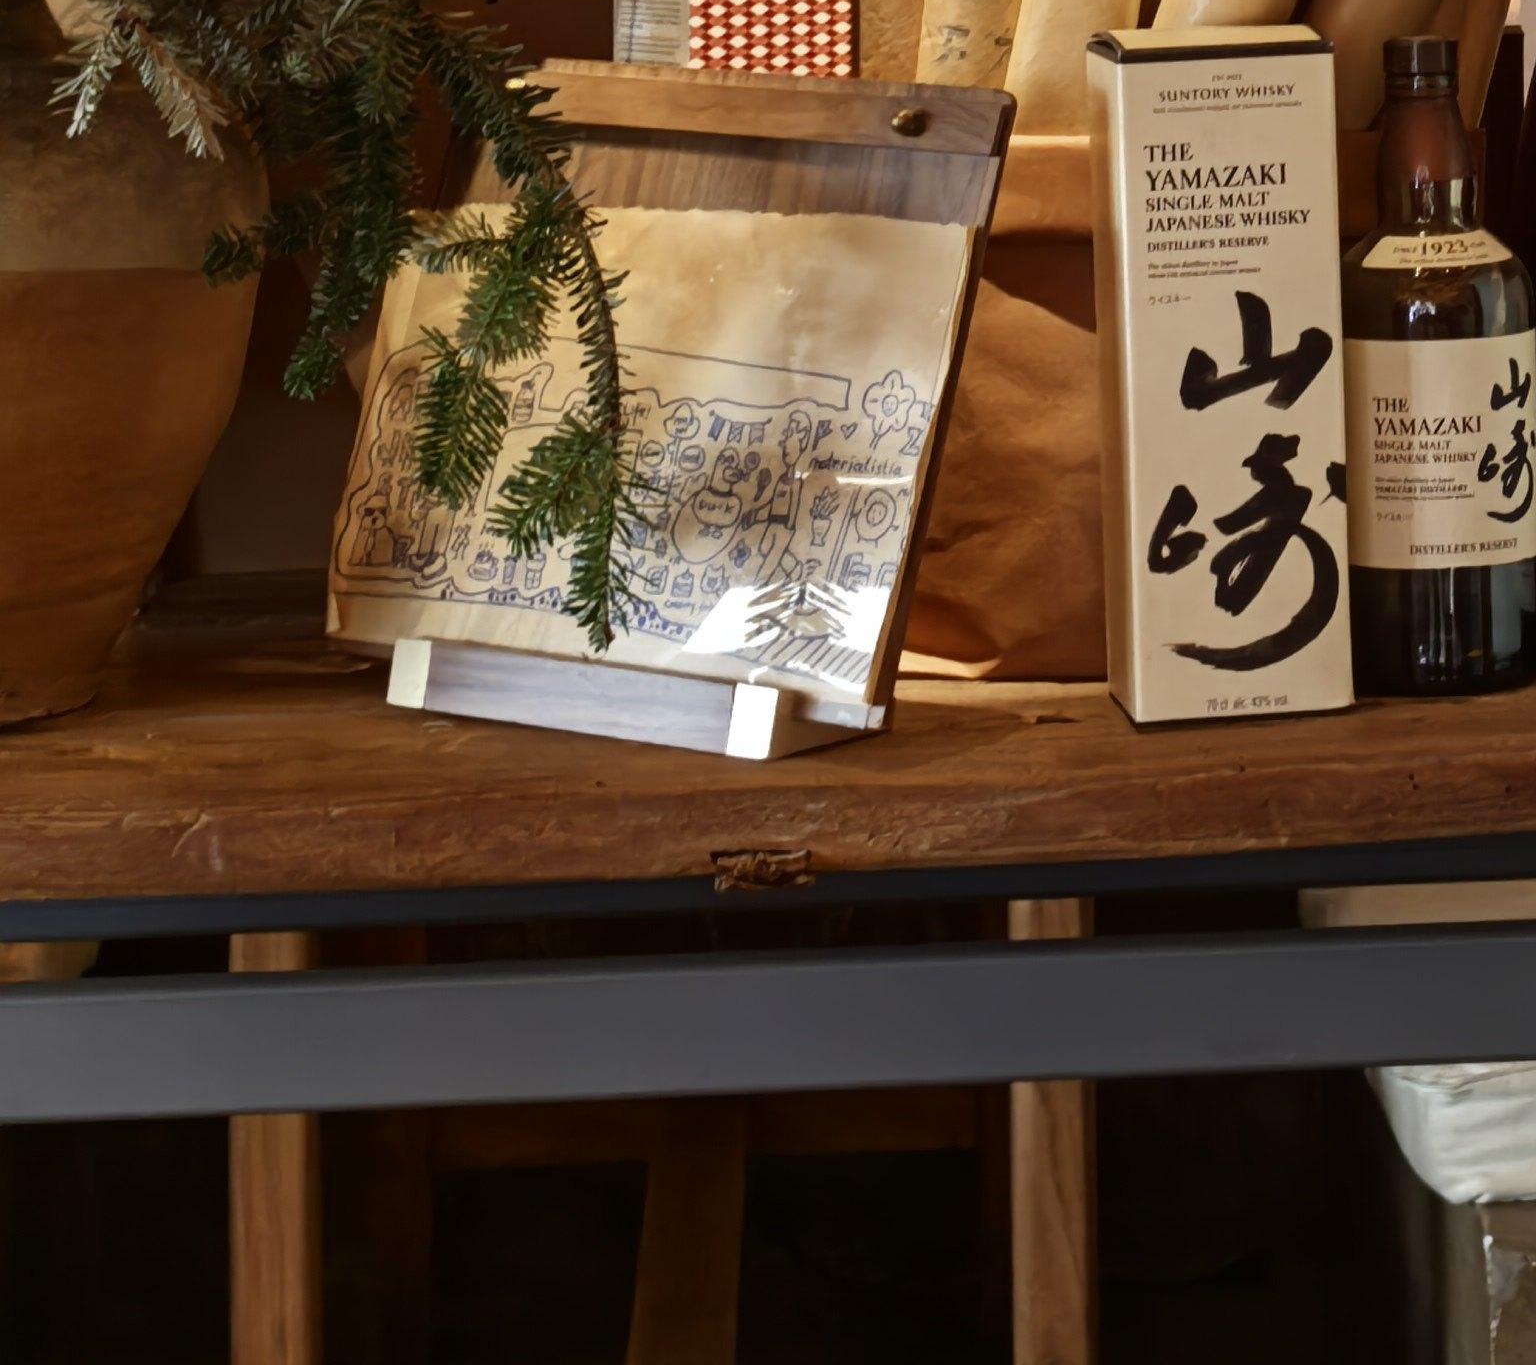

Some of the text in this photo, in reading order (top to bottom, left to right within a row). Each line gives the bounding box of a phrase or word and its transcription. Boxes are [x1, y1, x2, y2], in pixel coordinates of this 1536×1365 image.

[1158, 82, 1296, 103] SUNTORY WHISKY
[1143, 142, 1194, 163] THE
[1145, 163, 1288, 192] YAMAZAKI
[1145, 190, 1271, 213] SINGLE MALT
[1145, 208, 1312, 233] JAPANESE WHISKY
[1147, 236, 1270, 253] DISTILLER'S RESERVE
[1422, 239, 1469, 256] 1923
[1372, 396, 1410, 413] THE
[1374, 415, 1482, 436] YAMAZAKI
[1374, 439, 1453, 451] SINGLE MALT
[1374, 451, 1478, 465] JAPANESE WHISKY
[1410, 543, 1477, 556] DISTILLER'S
